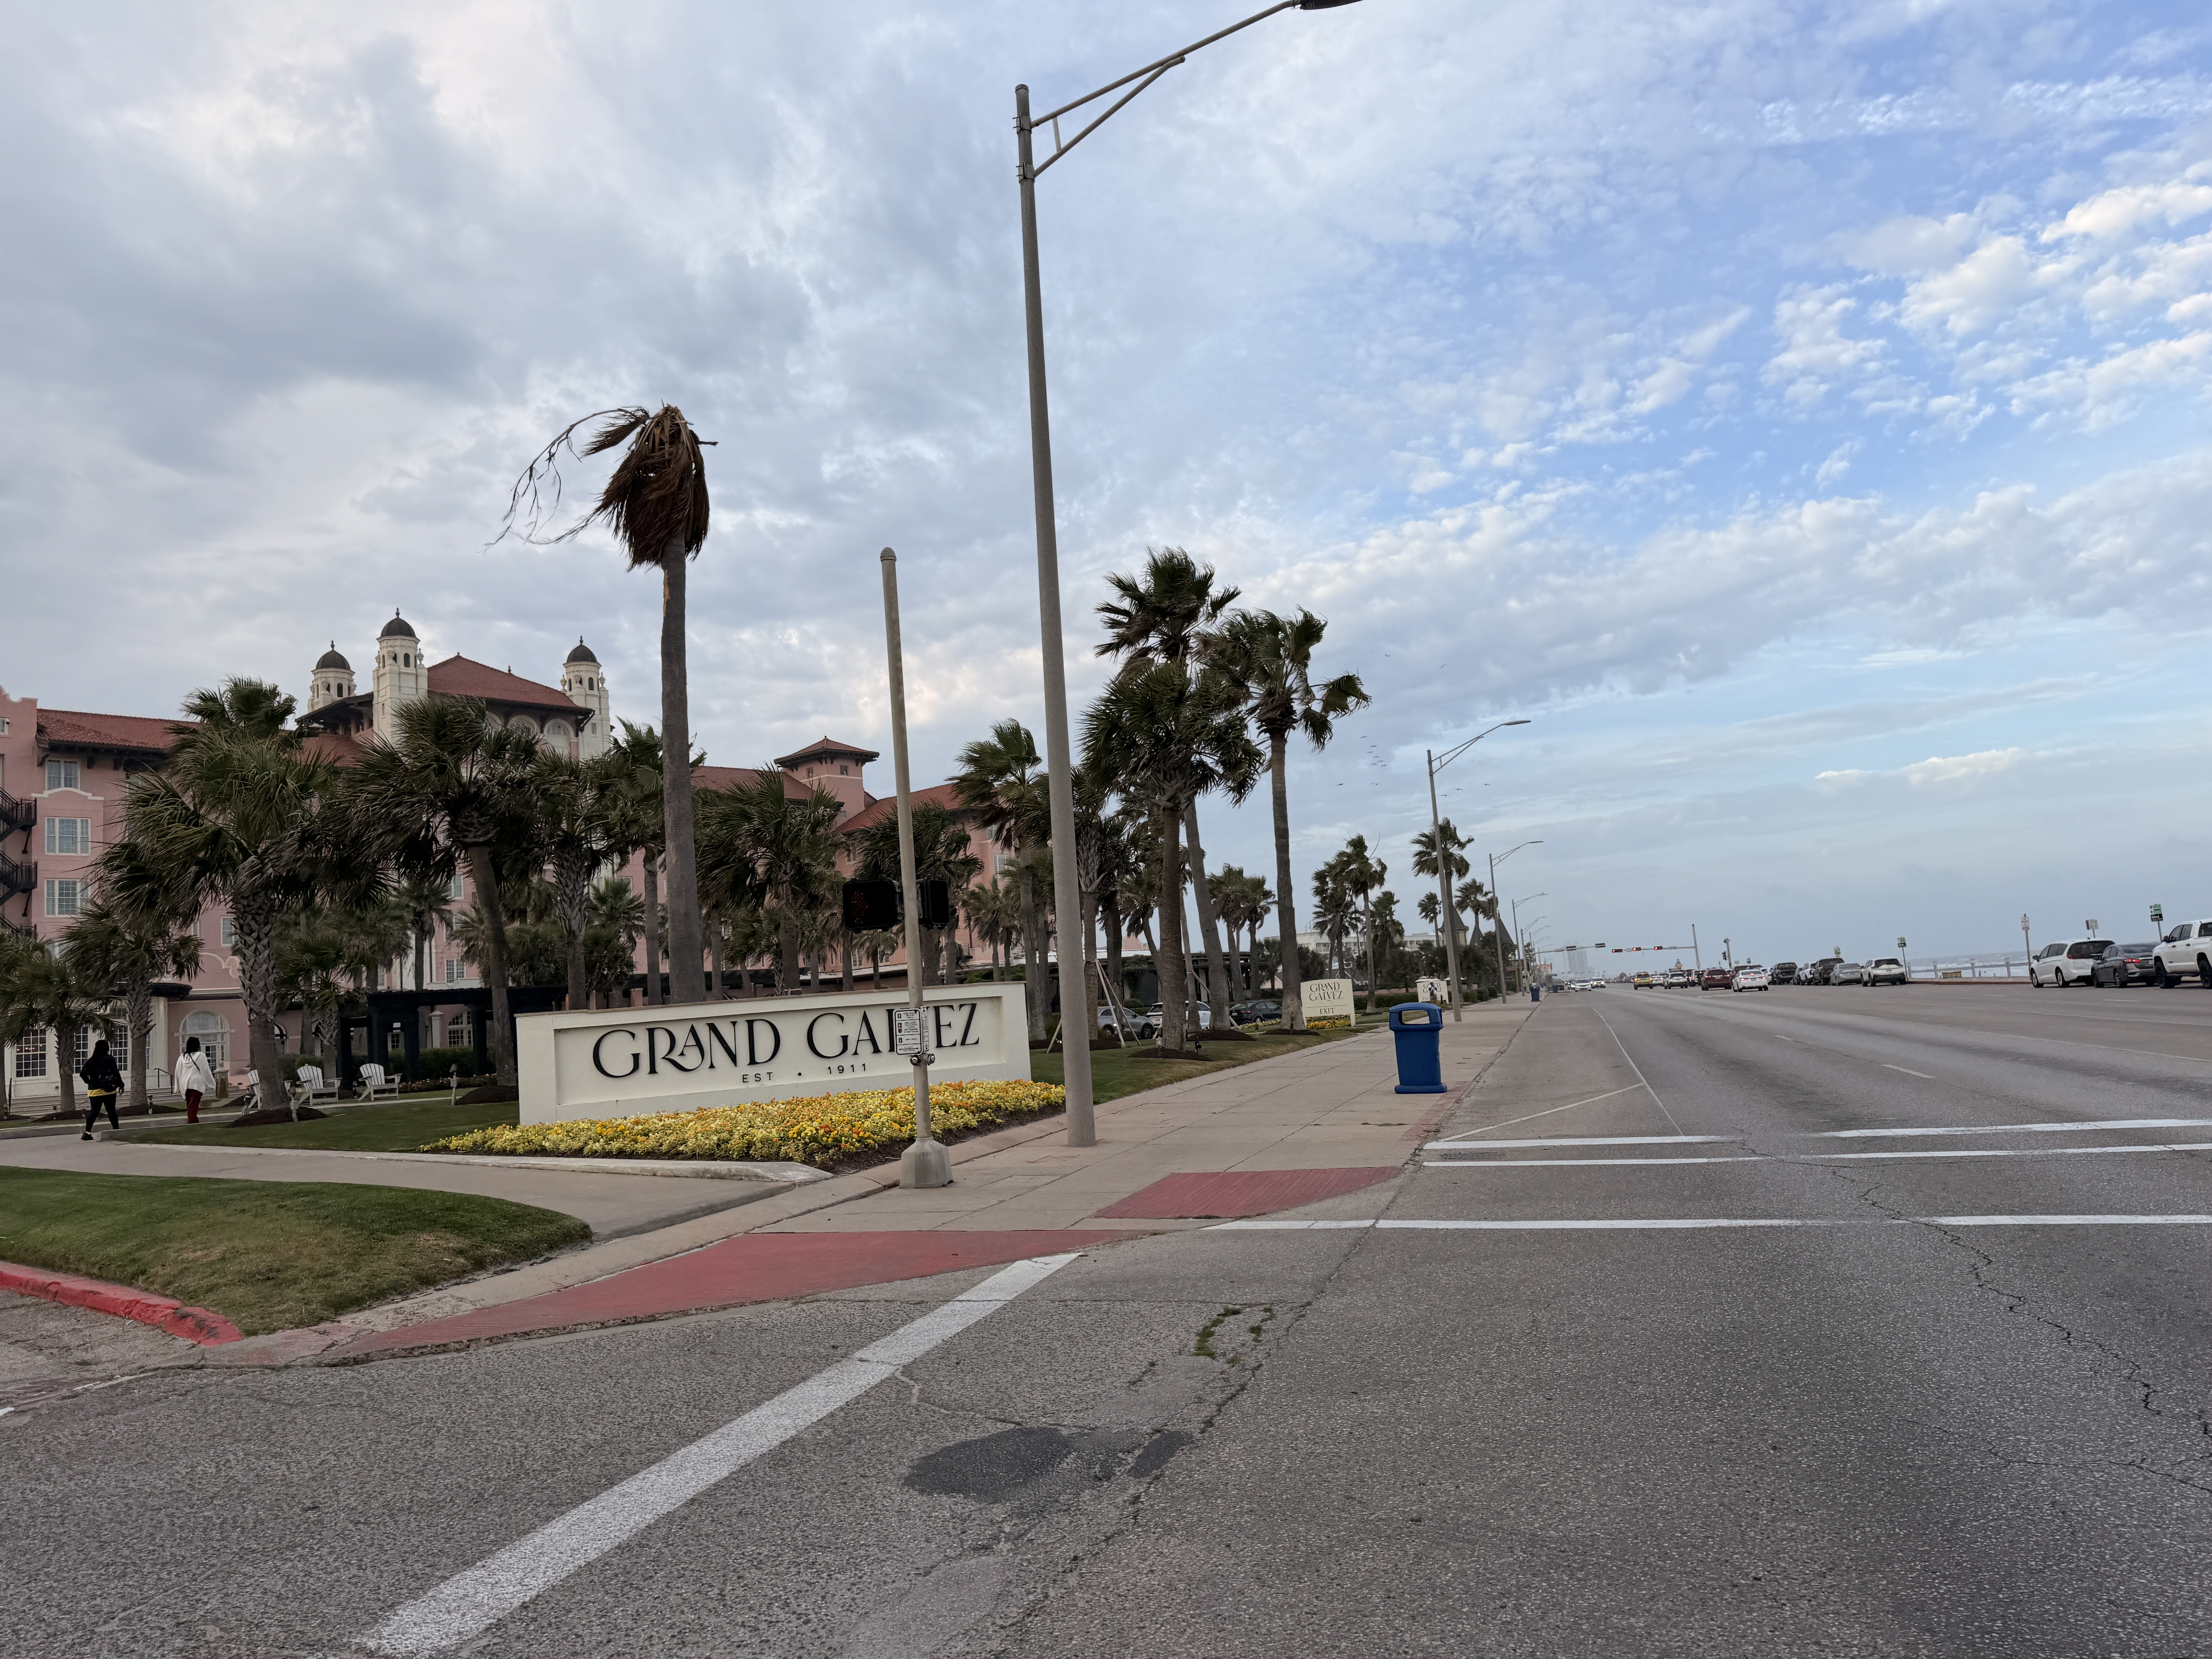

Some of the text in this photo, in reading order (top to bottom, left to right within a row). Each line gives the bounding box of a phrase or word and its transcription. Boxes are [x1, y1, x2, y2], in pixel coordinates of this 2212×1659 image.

[1310, 982, 1340, 992] GRAND
[1309, 991, 1343, 1001] GALVEZ
[592, 1003, 979, 1078] GRAND GAEZ
[742, 1063, 866, 1083] EST 1911
